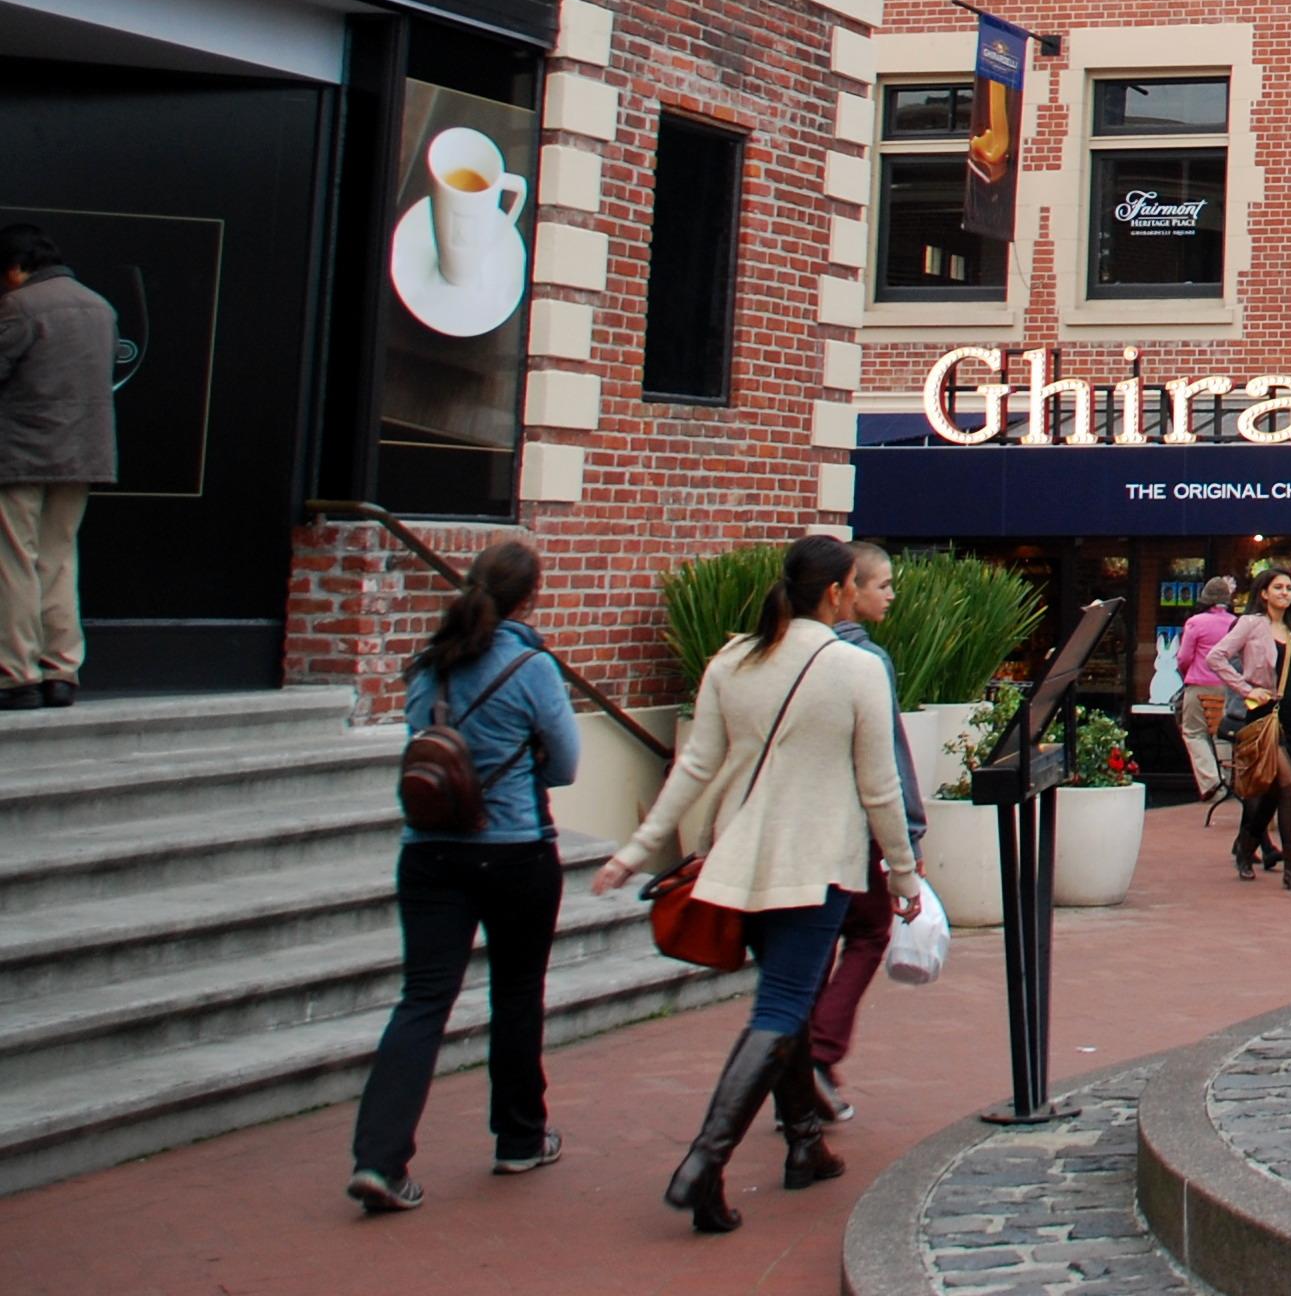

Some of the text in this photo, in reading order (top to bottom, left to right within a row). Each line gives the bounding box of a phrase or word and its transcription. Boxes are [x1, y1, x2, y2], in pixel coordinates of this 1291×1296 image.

[1115, 190, 1208, 221] Fairmont
[1131, 218, 1196, 227] HERITAGE PLACE
[1125, 483, 1166, 500] THE
[1173, 482, 1269, 500] ORIGINAL
